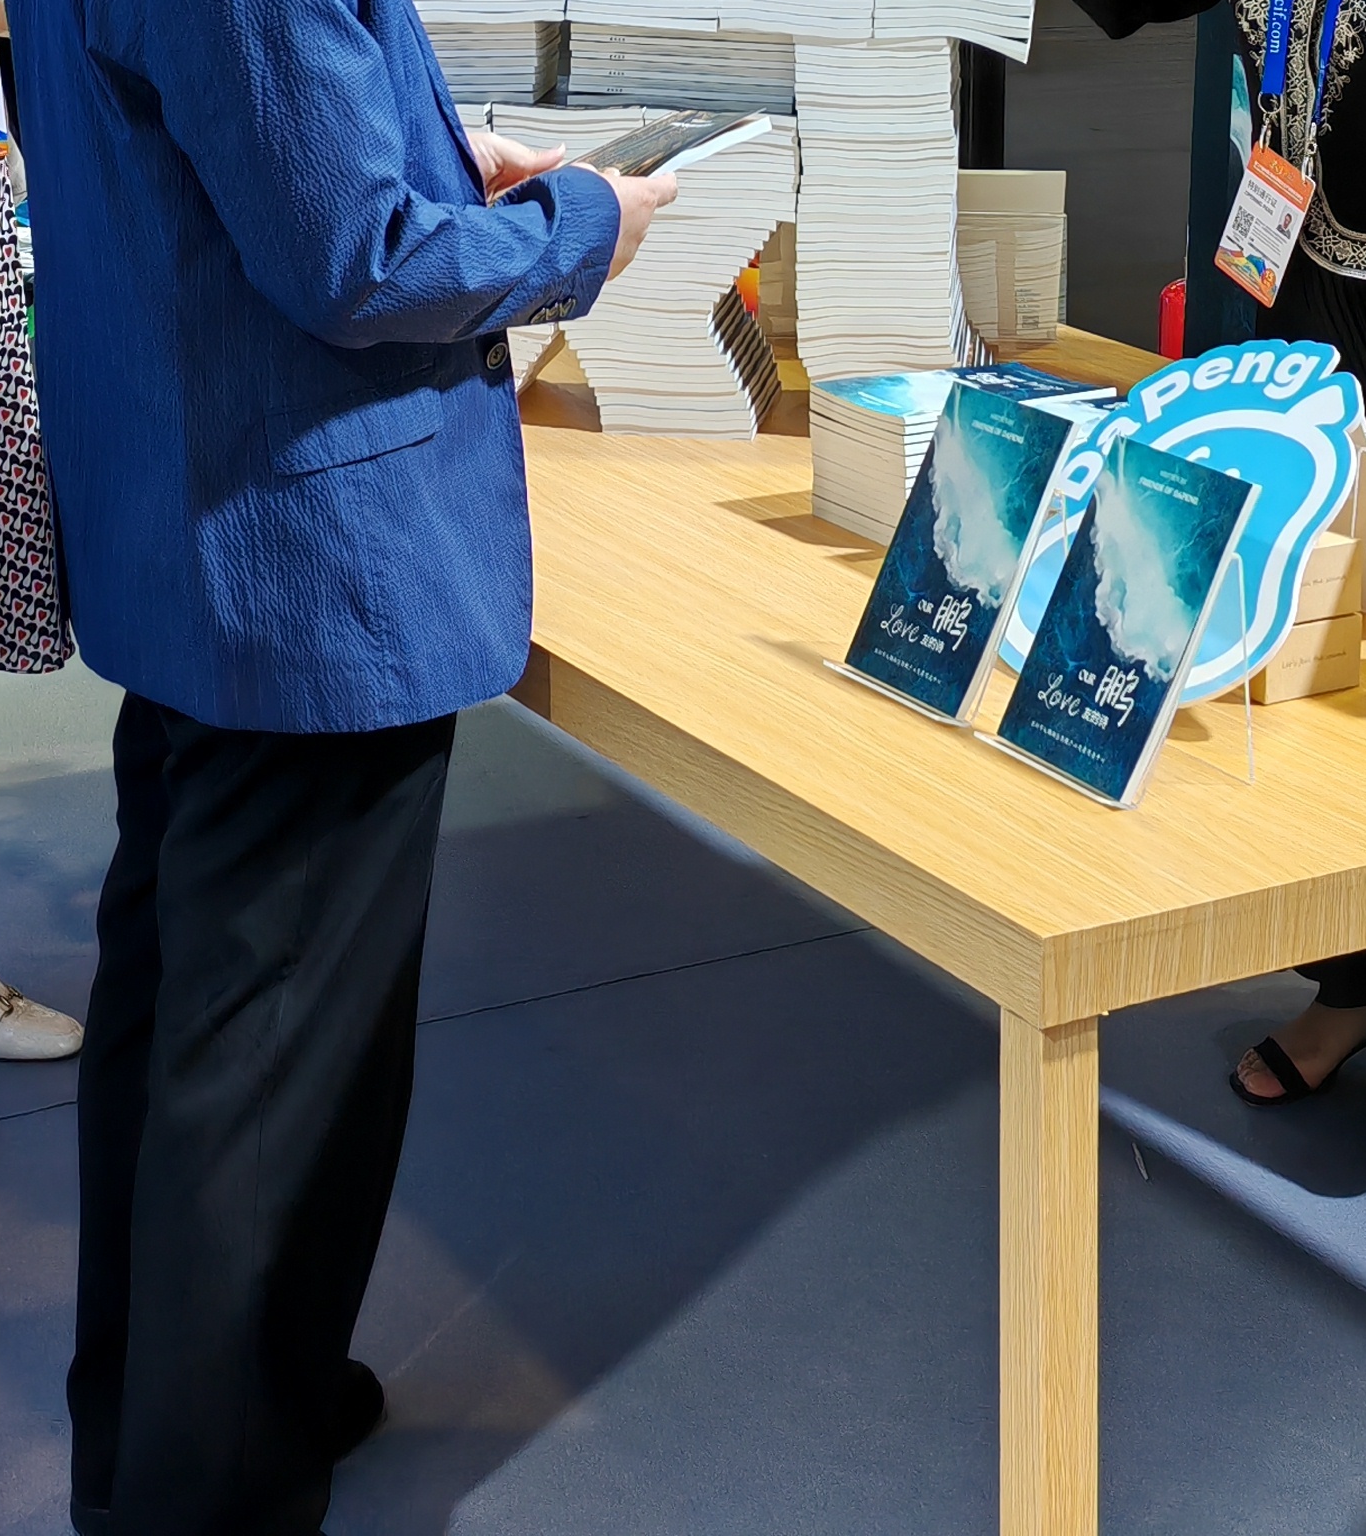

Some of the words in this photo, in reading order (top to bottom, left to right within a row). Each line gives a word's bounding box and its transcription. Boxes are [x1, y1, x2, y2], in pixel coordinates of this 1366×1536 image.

[880, 602, 920, 641] Love
[932, 594, 973, 651] 鹏
[1037, 673, 1080, 716] Love
[1078, 668, 1096, 687] OUR
[1094, 665, 1140, 727] 鹏
